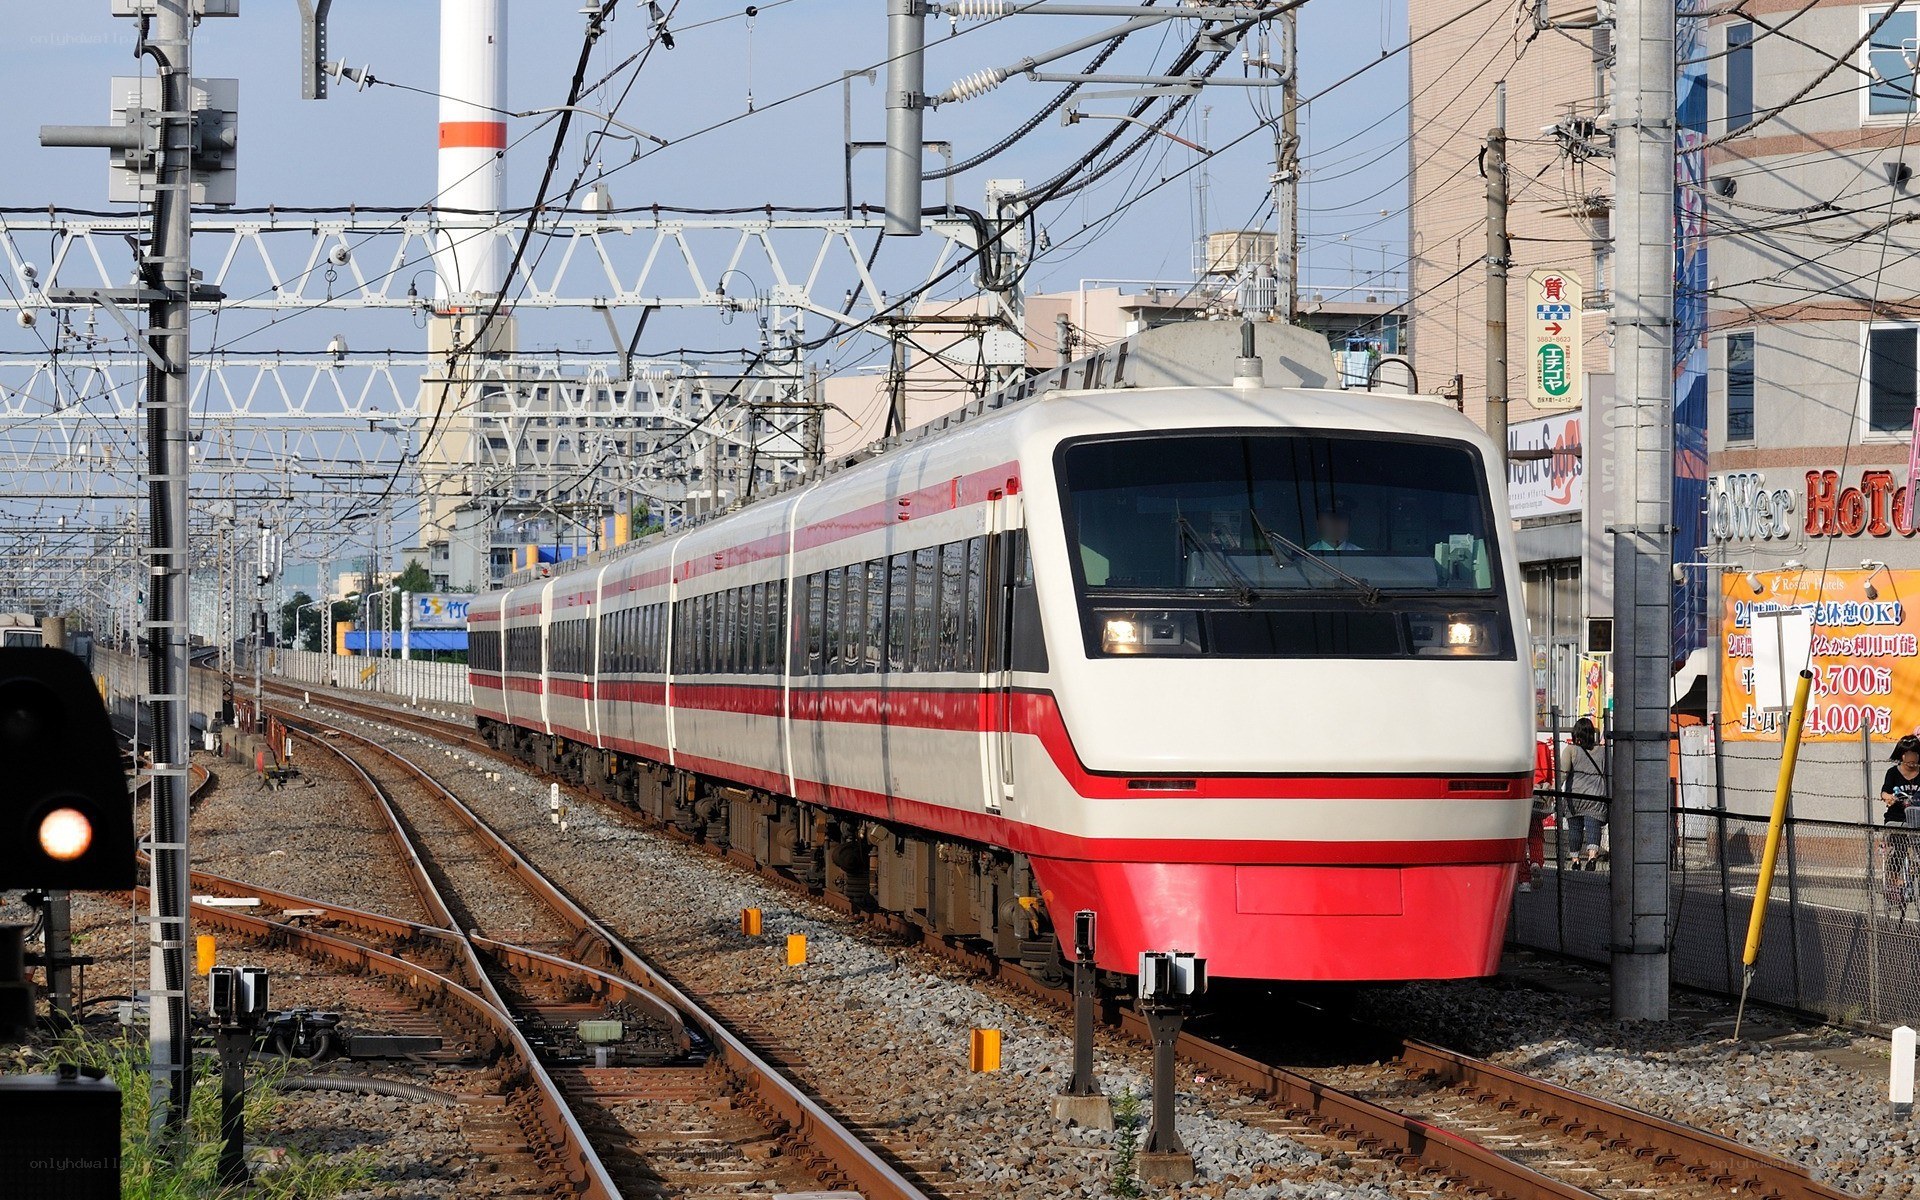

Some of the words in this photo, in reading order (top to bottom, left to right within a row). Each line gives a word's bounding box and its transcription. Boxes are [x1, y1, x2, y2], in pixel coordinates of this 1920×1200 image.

[1545, 278, 1563, 300] 質
[1545, 348, 1563, 390] エチゴヤ
